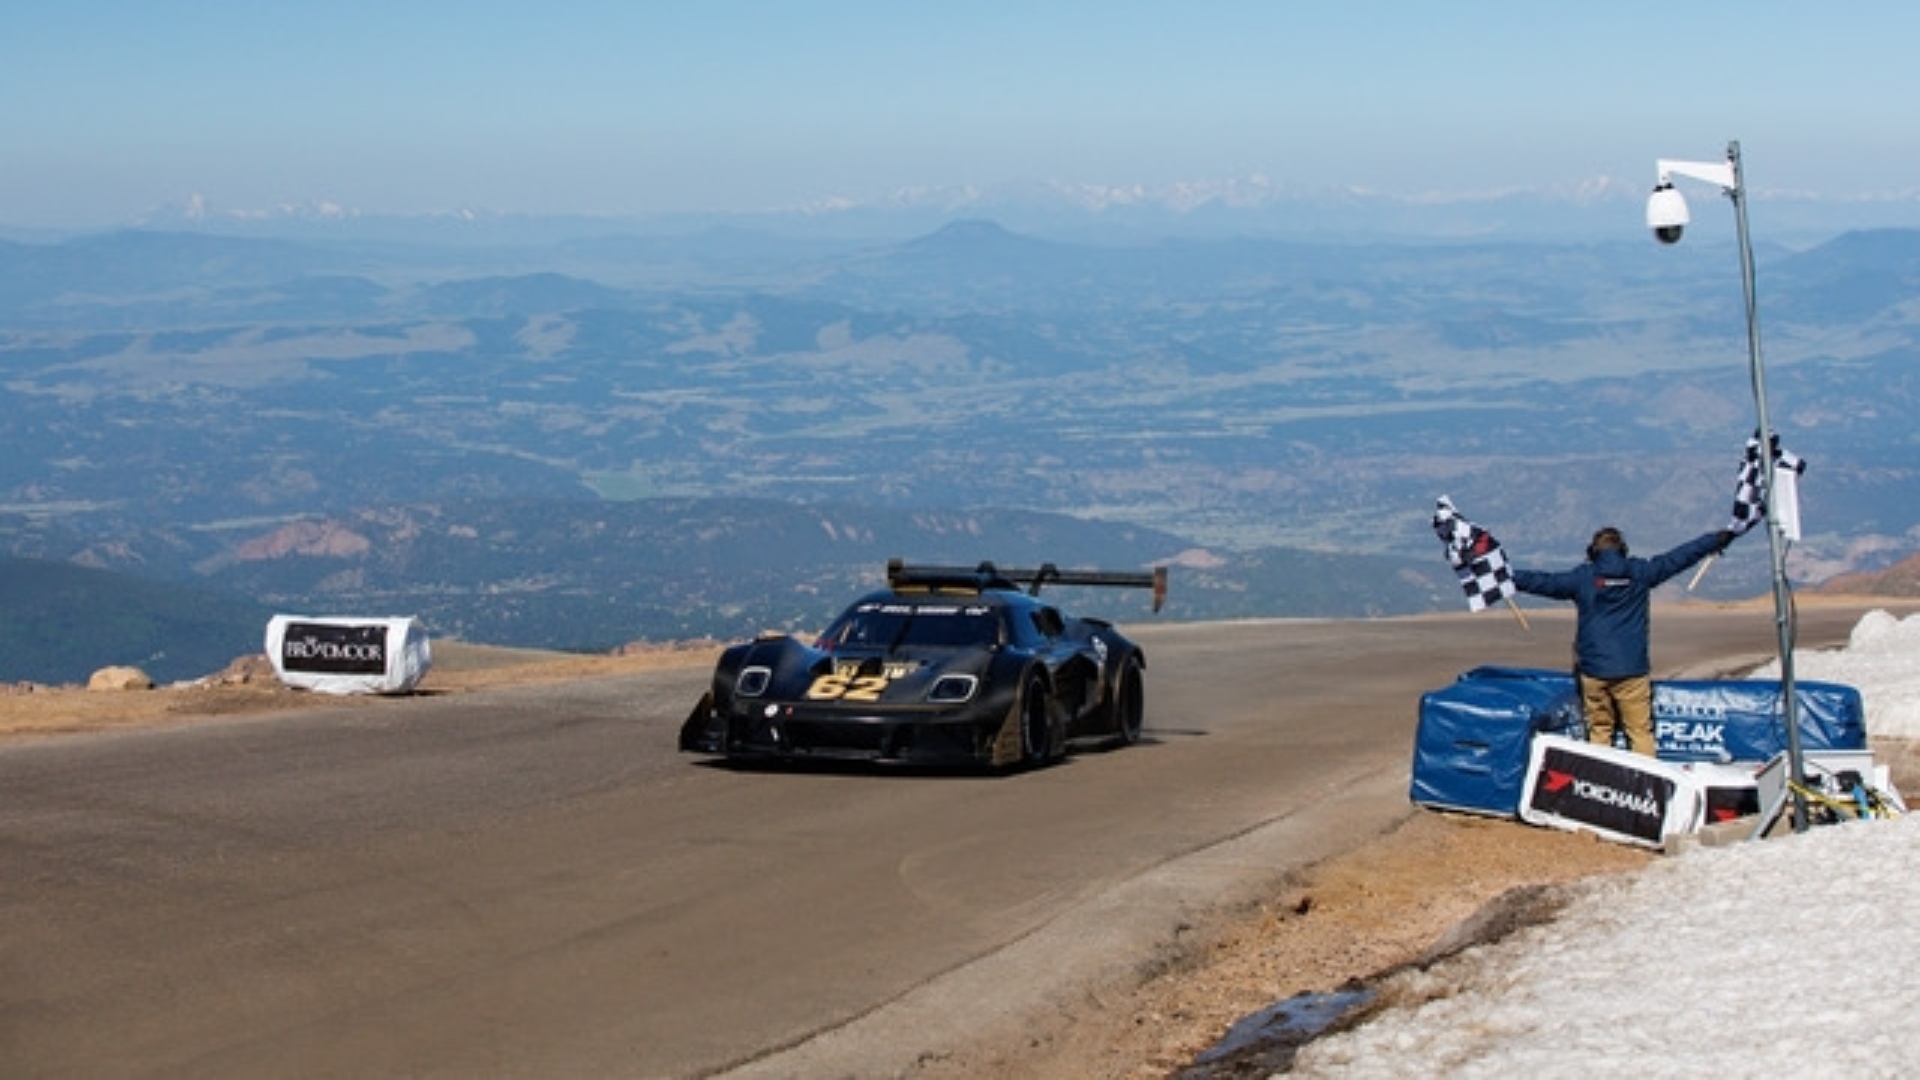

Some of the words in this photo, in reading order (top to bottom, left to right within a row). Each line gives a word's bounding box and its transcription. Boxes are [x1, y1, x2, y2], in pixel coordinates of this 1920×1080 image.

[286, 640, 382, 660] BROADMOOR
[807, 673, 888, 701] 62
[1656, 721, 1724, 741] PEAK
[1573, 779, 1660, 818] YOKOHAMA
